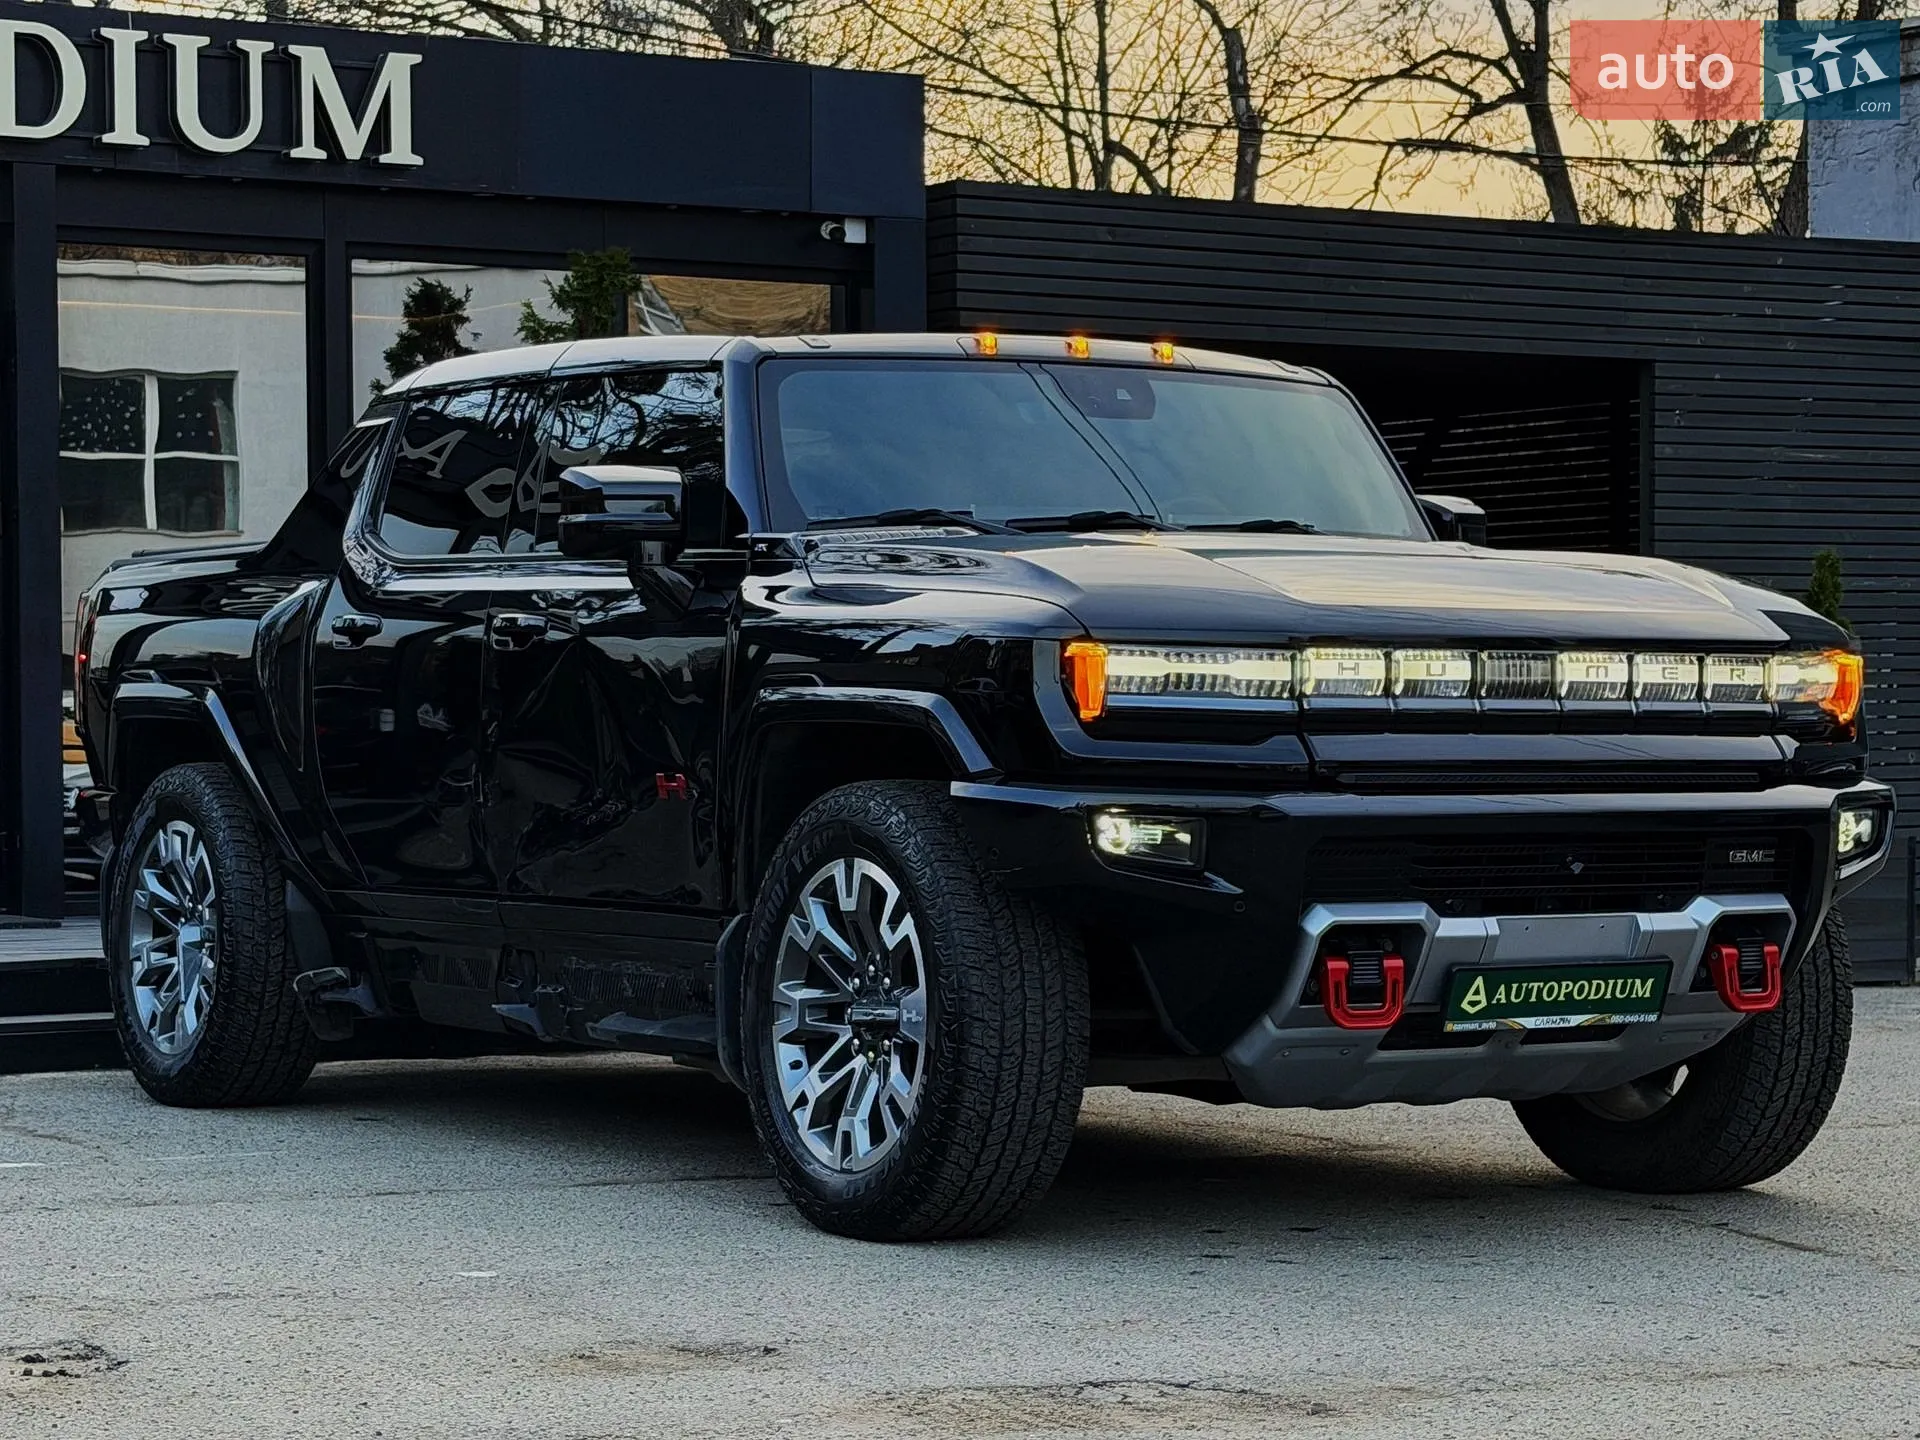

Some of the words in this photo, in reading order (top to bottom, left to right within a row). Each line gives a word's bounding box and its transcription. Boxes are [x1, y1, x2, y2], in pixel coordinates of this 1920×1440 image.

[0, 19, 424, 166] DIUM
[1729, 849, 1776, 863] GMC
[1491, 977, 1656, 1005] AUTOPODIUM
